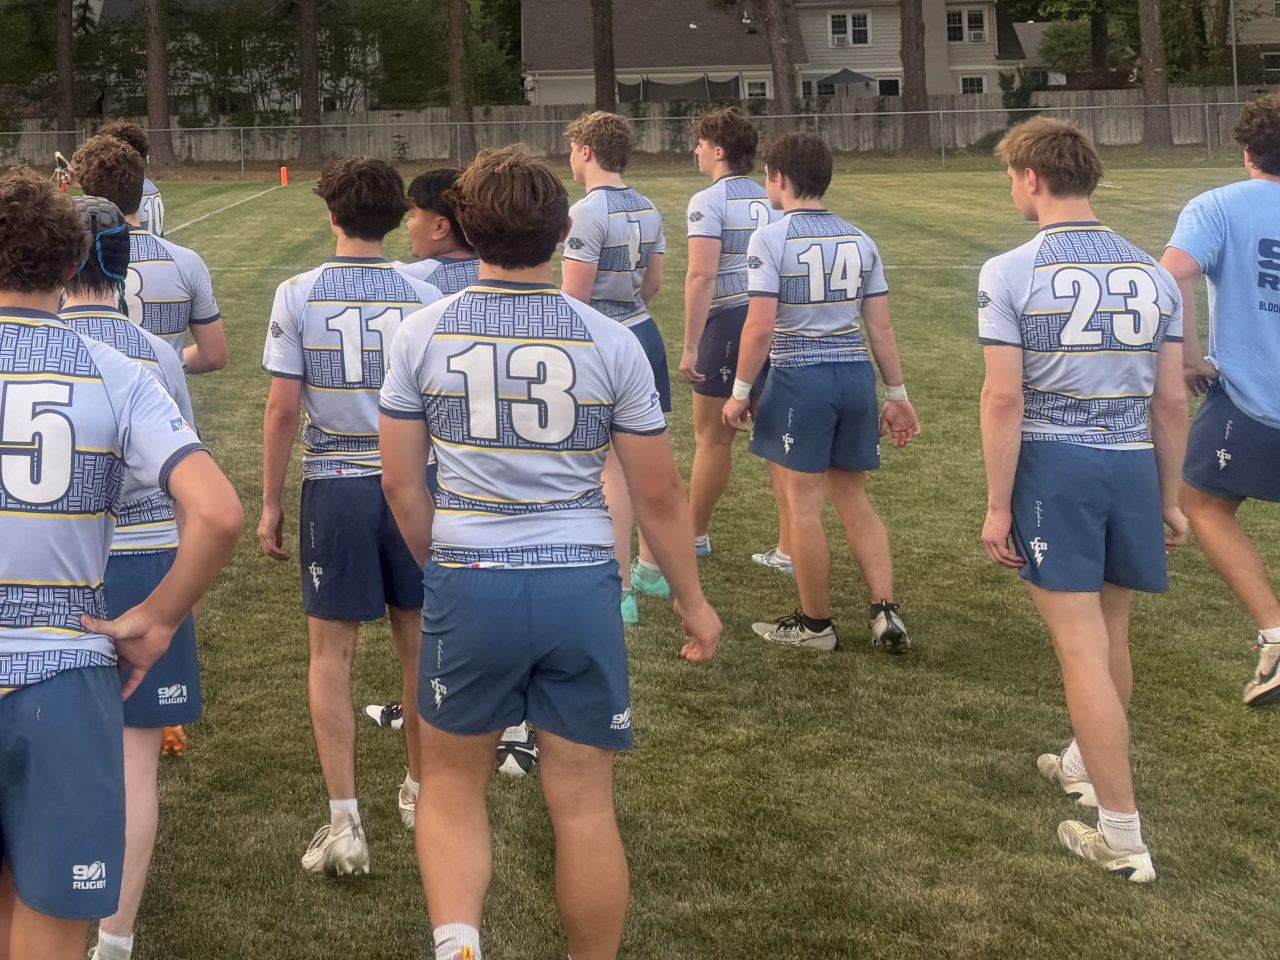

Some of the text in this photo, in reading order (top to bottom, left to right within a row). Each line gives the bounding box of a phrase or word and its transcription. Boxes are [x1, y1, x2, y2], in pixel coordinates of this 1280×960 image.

[797, 241, 863, 302] 14
[1051, 266, 1161, 346] 23
[325, 306, 403, 384] 11
[447, 341, 578, 444] 13
[159, 696, 188, 705] RUGBY
[72, 880, 106, 890] RUGBY
